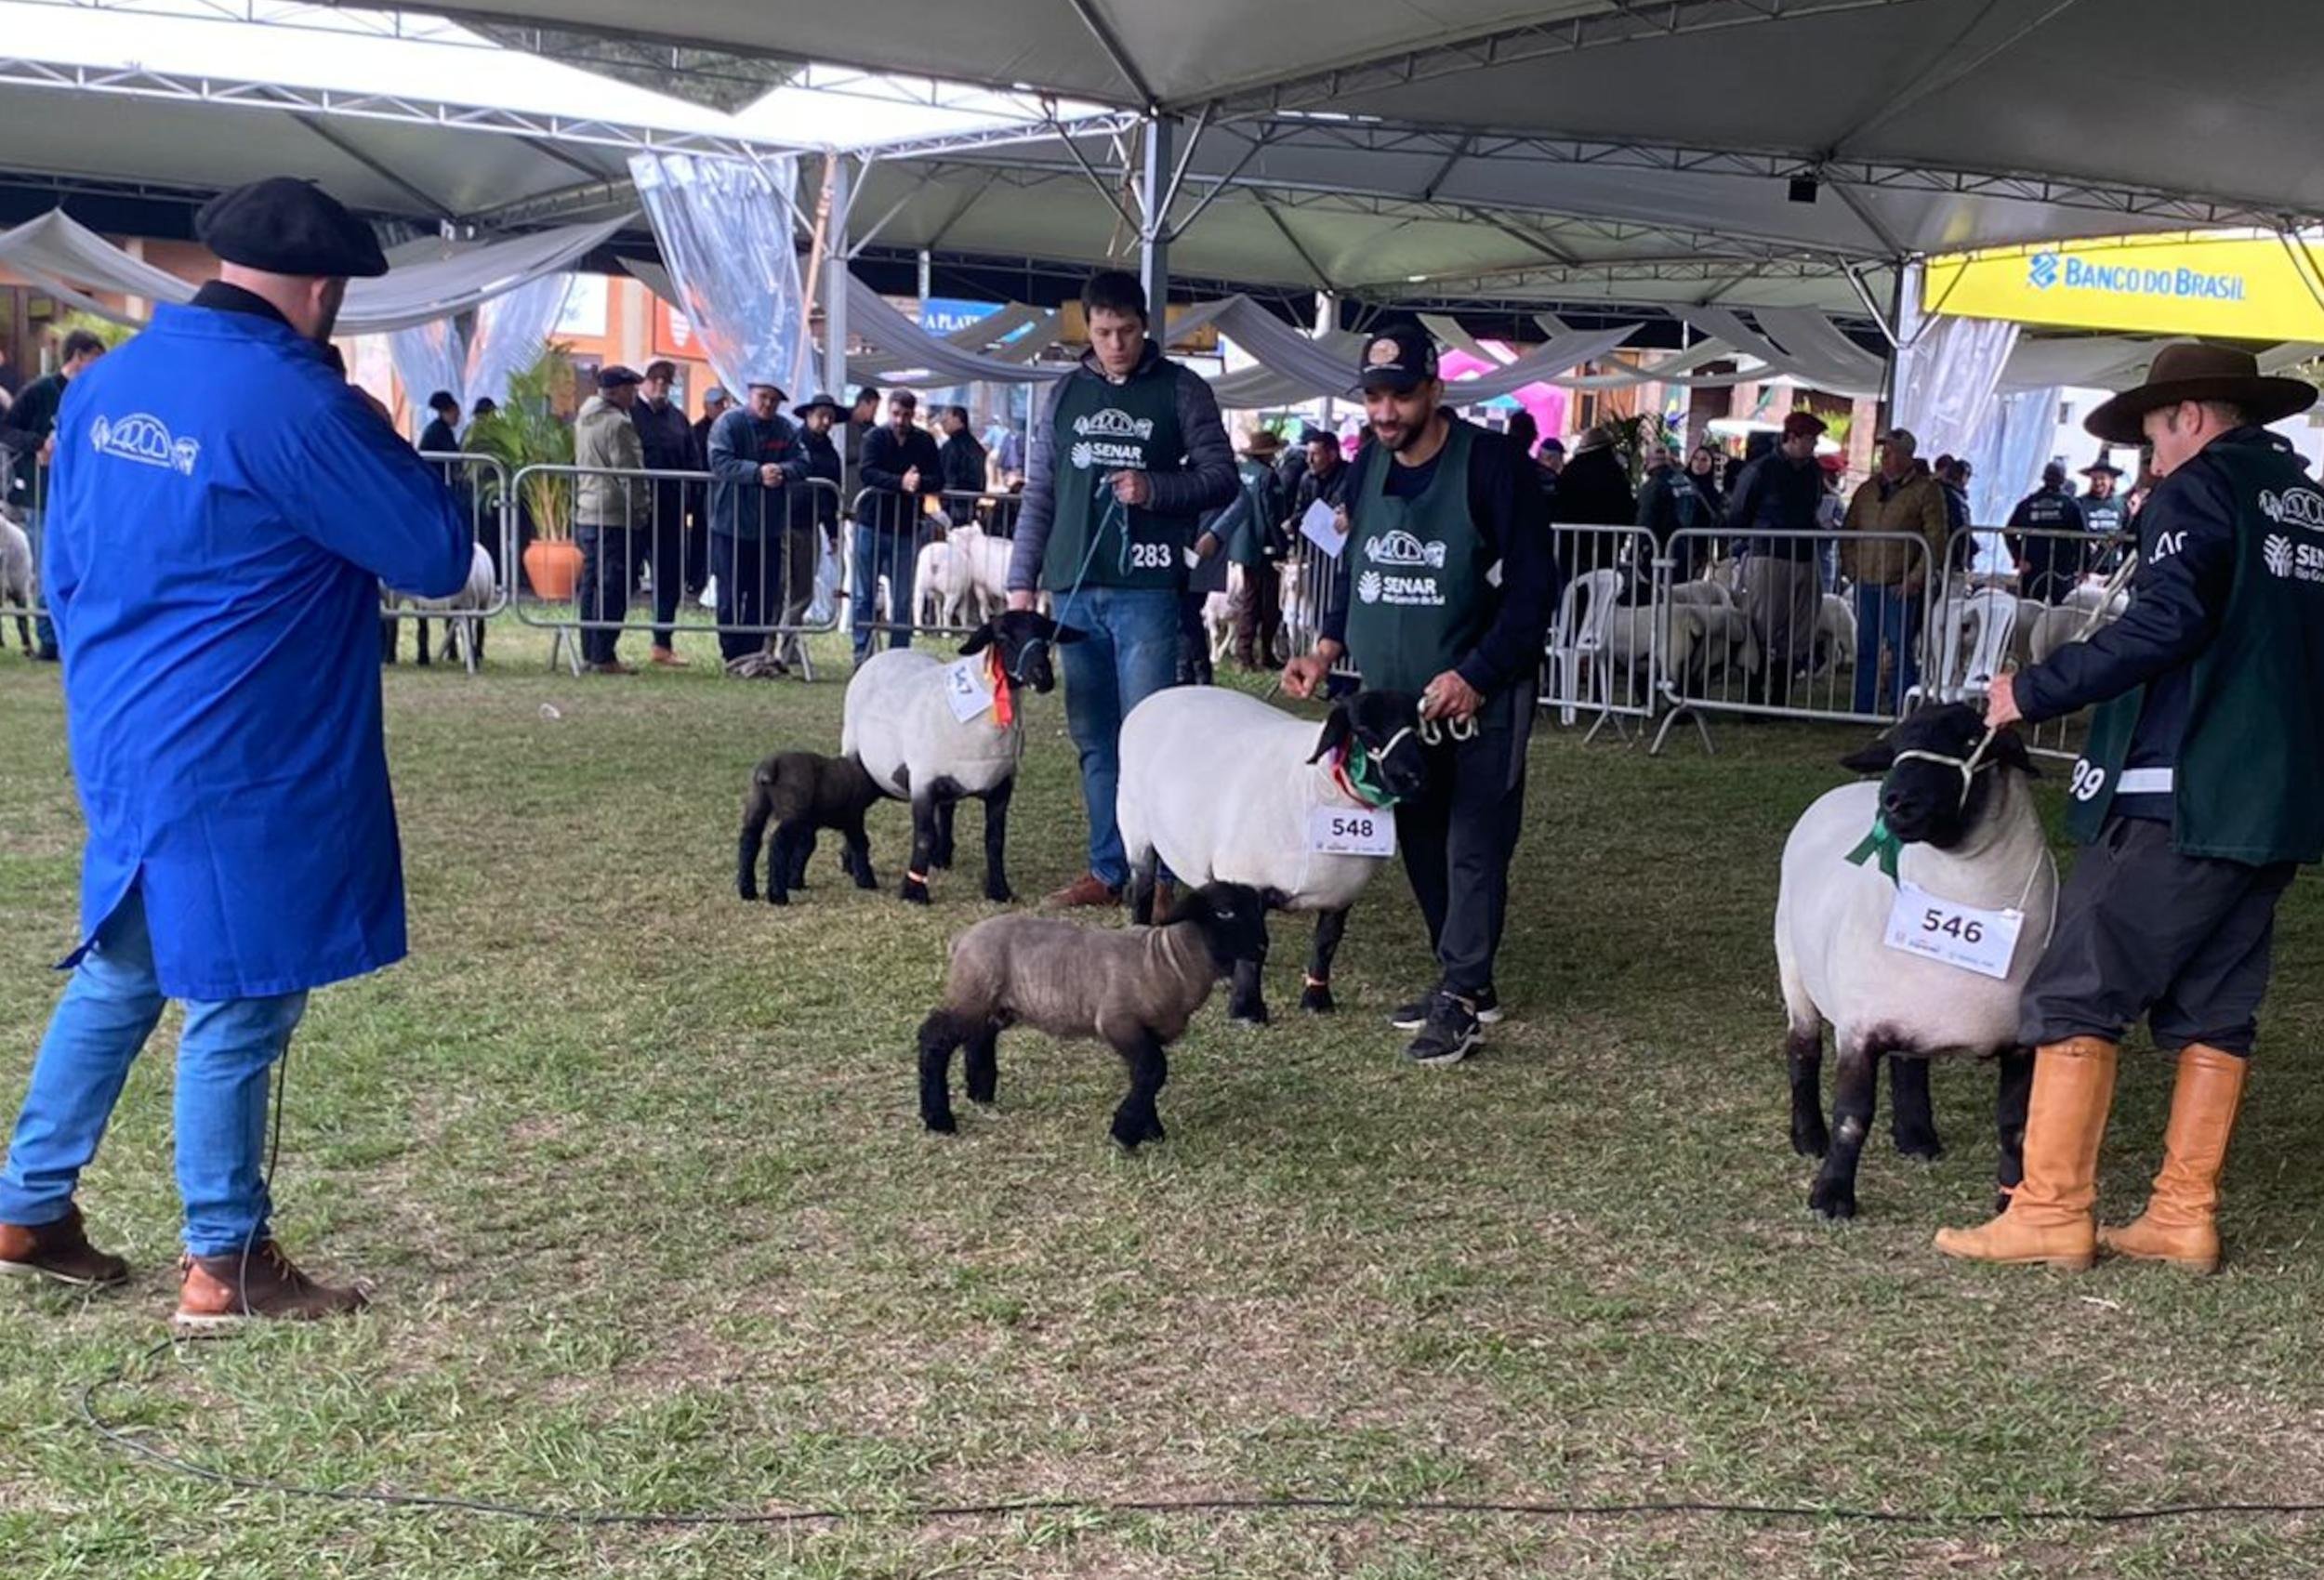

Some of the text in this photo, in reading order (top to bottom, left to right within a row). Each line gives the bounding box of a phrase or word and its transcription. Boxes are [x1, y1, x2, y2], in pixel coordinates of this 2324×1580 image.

[2065, 257, 2246, 300] BANCO DO BRASIL
[1092, 442, 1142, 461] SENAR
[1131, 543, 1172, 568] 283
[1382, 576, 1437, 595] SENAR
[1332, 818, 1373, 837] 548
[1921, 908, 1984, 944] 546
